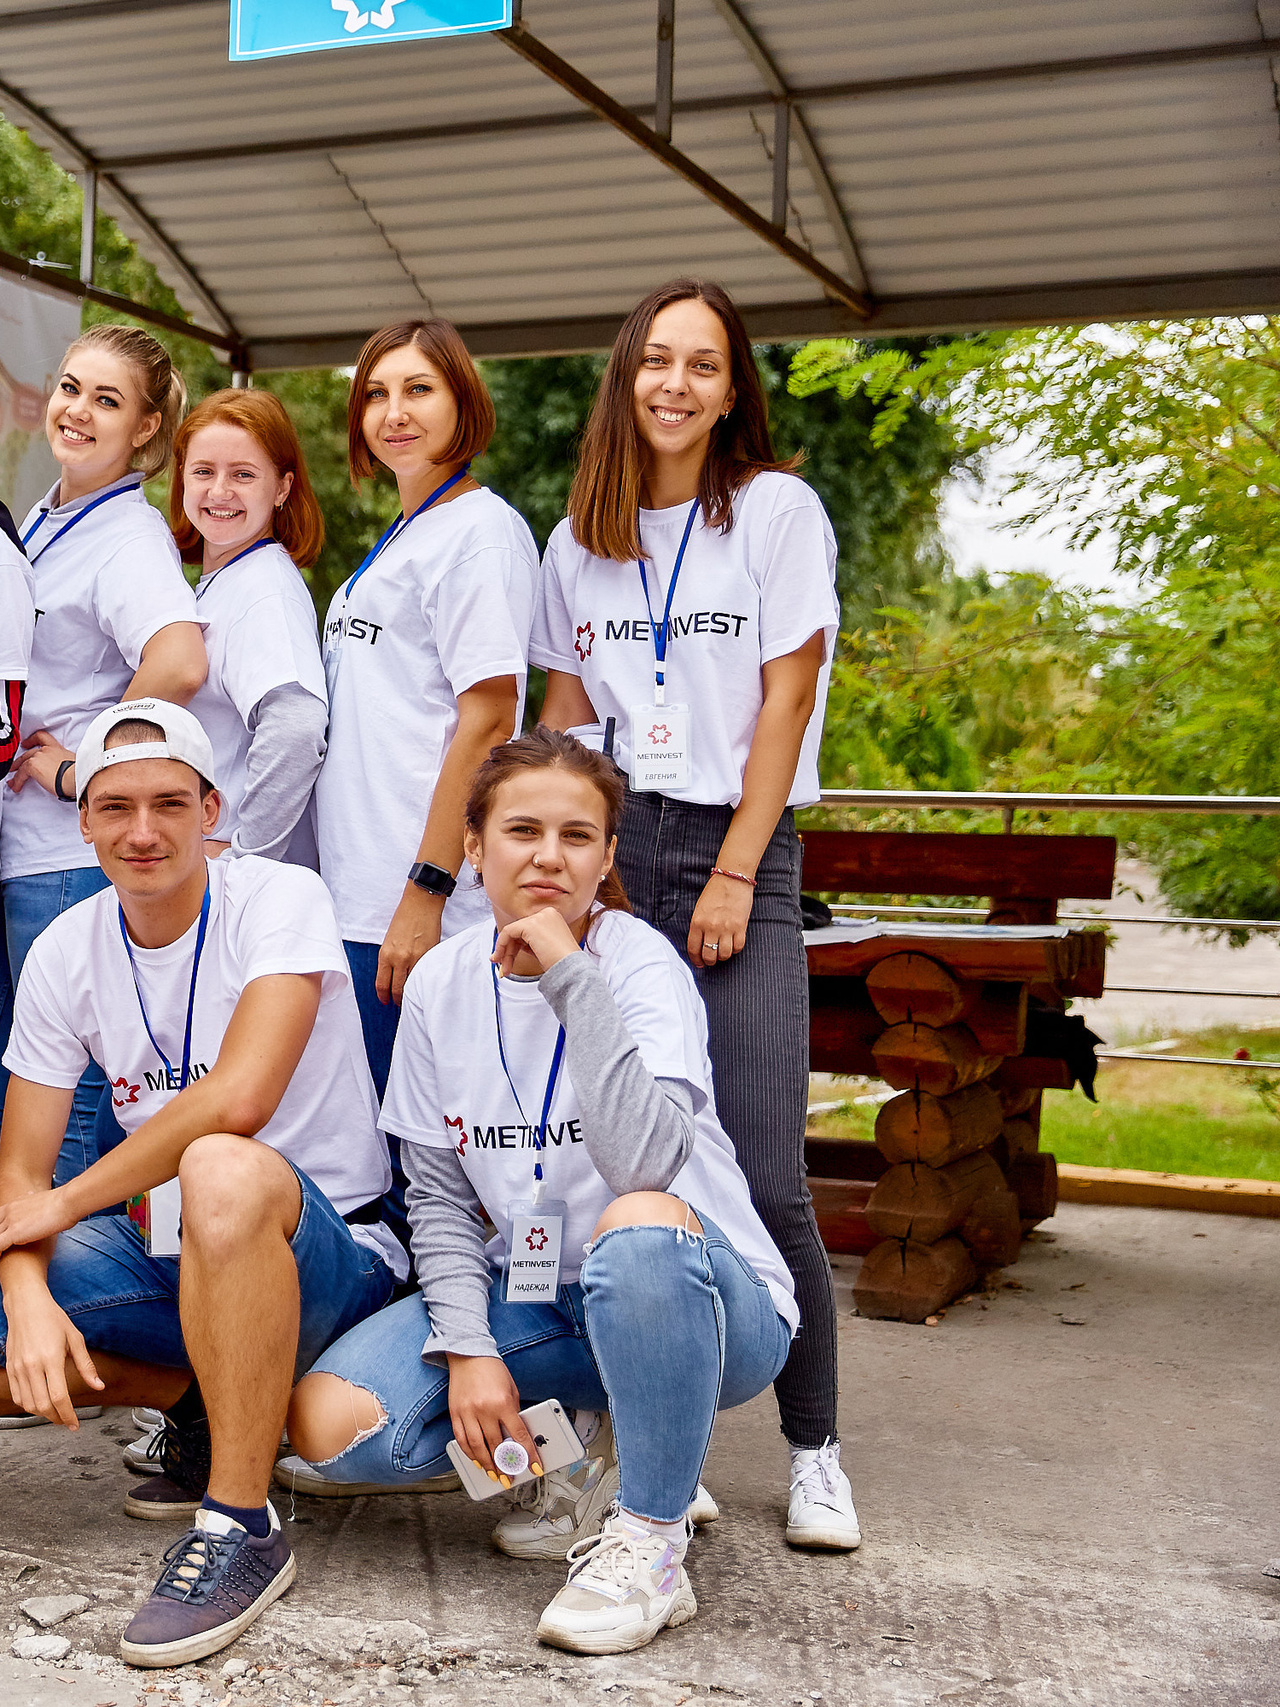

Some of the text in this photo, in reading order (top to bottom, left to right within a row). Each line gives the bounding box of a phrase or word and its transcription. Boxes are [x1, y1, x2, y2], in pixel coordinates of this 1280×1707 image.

[636, 752, 683, 760] METINVEST
[512, 1260, 557, 1268] METINVEST
[513, 1283, 551, 1292] НАДЕЖДА
